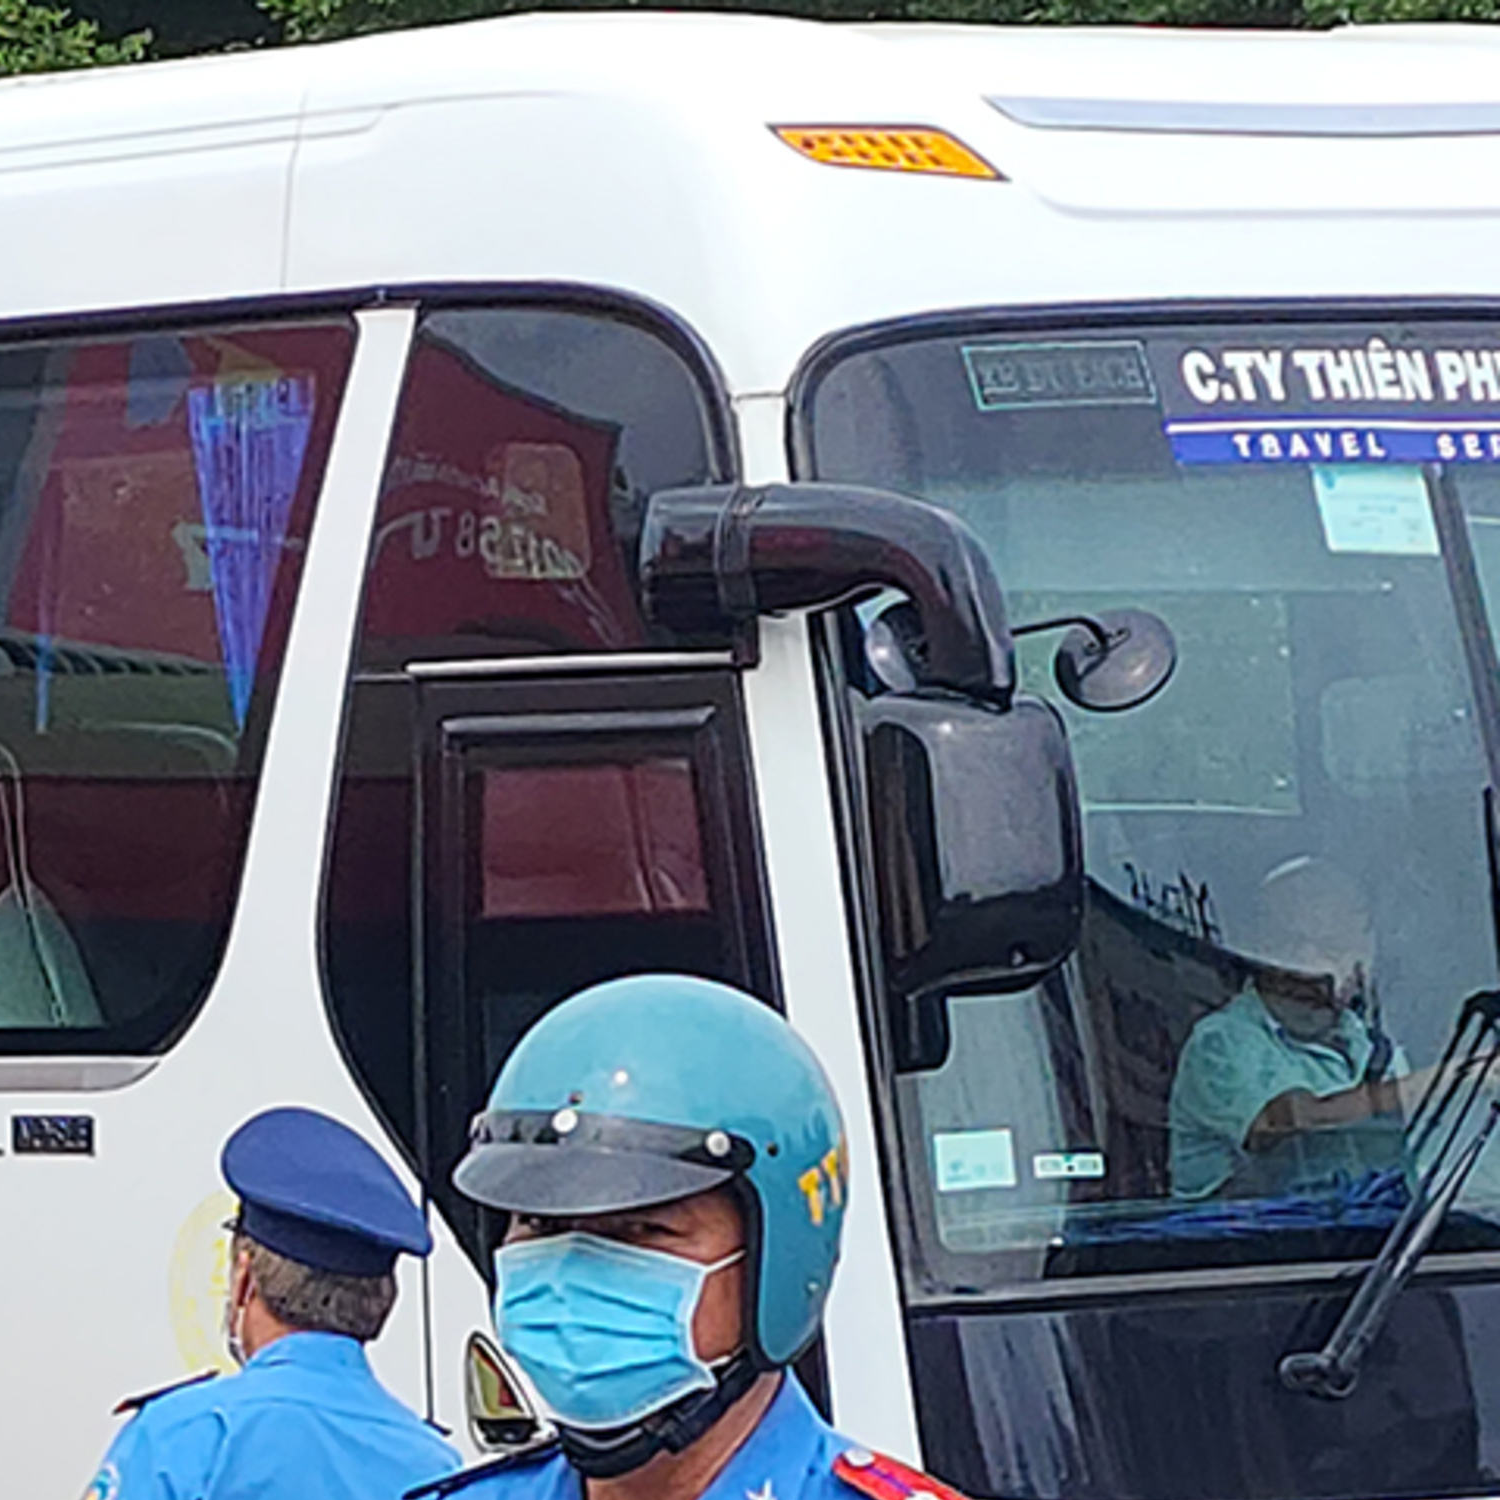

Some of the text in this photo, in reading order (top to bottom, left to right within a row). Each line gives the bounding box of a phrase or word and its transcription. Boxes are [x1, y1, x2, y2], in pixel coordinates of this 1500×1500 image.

[1181, 337, 1500, 403] C.TY THIÊN PH
[1231, 432, 1387, 458] TRAVEL
